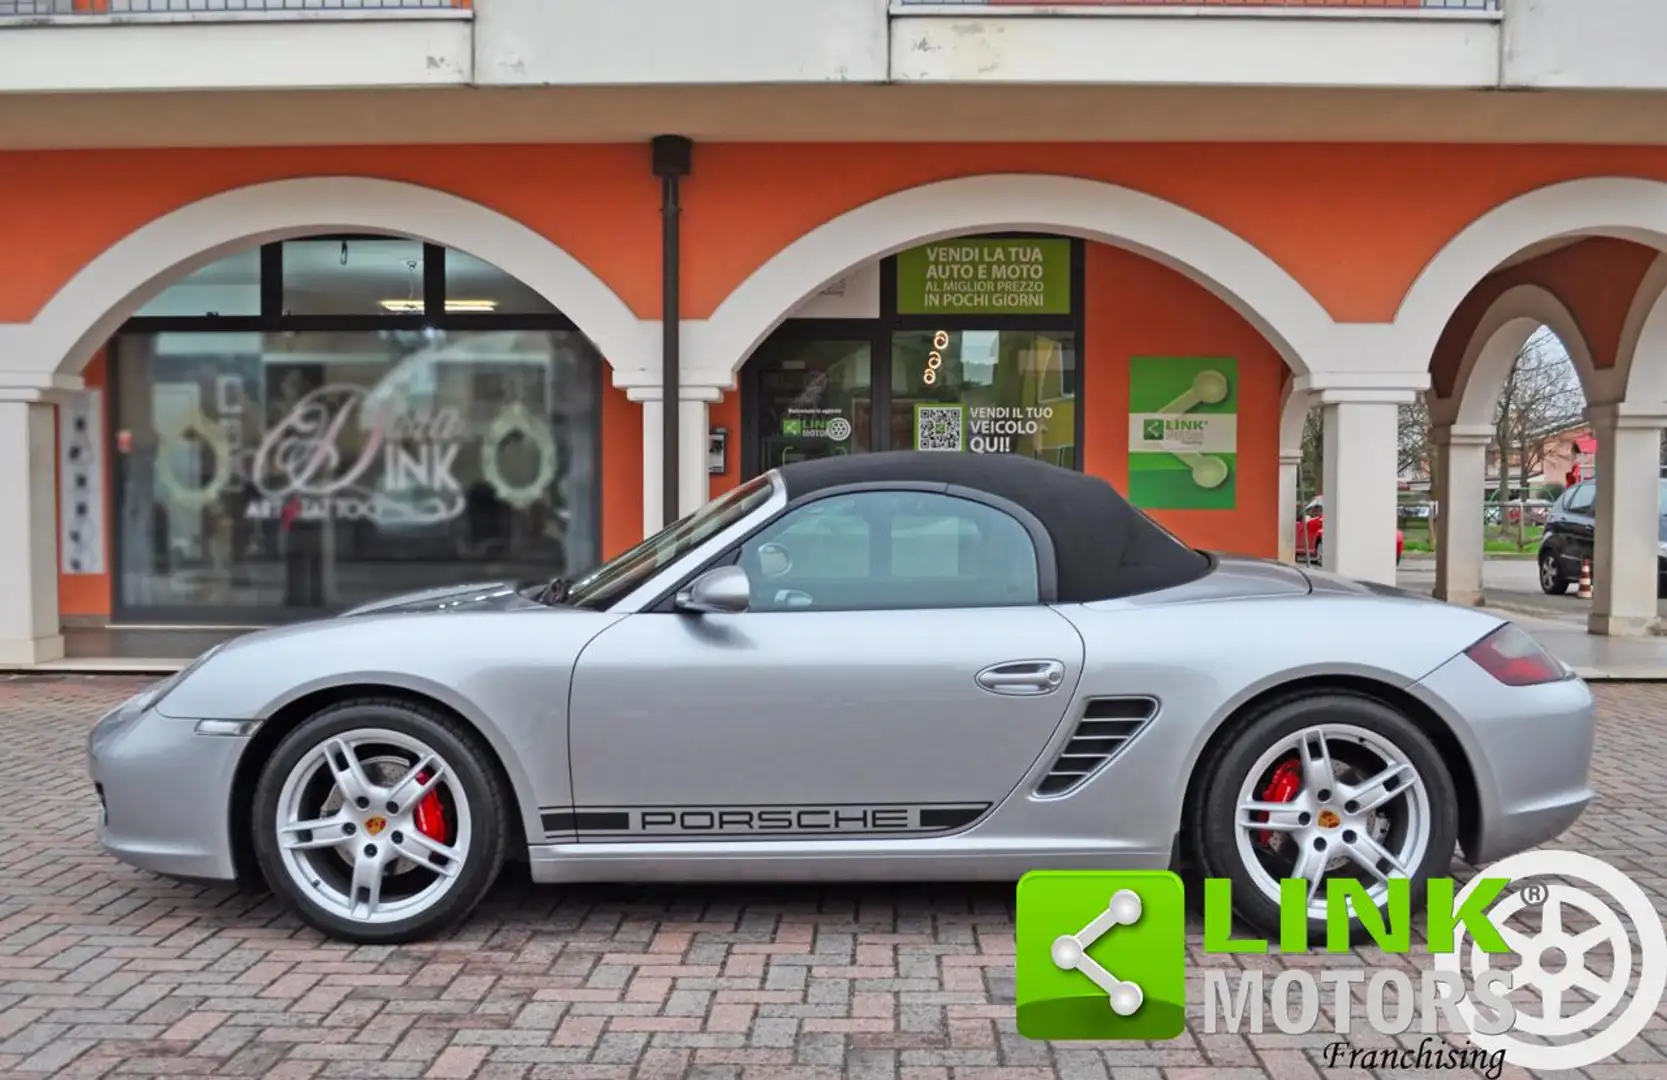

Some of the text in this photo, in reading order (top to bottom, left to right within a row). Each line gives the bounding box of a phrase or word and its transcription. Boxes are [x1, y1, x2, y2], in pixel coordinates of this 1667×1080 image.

[926, 247, 1043, 262] VENDI LA TUA
[925, 264, 1043, 279] AUTO E MOTO
[925, 281, 1044, 292] AL MIGLIOR PREZZO
[924, 293, 1044, 307] IN POCHI GIORNI
[970, 407, 1053, 418] VENDI IL TUO
[970, 420, 1038, 434] VEICOLO
[970, 436, 1011, 454] QUI!
[385, 442, 462, 491] INK
[641, 809, 908, 831] PORSCHE
